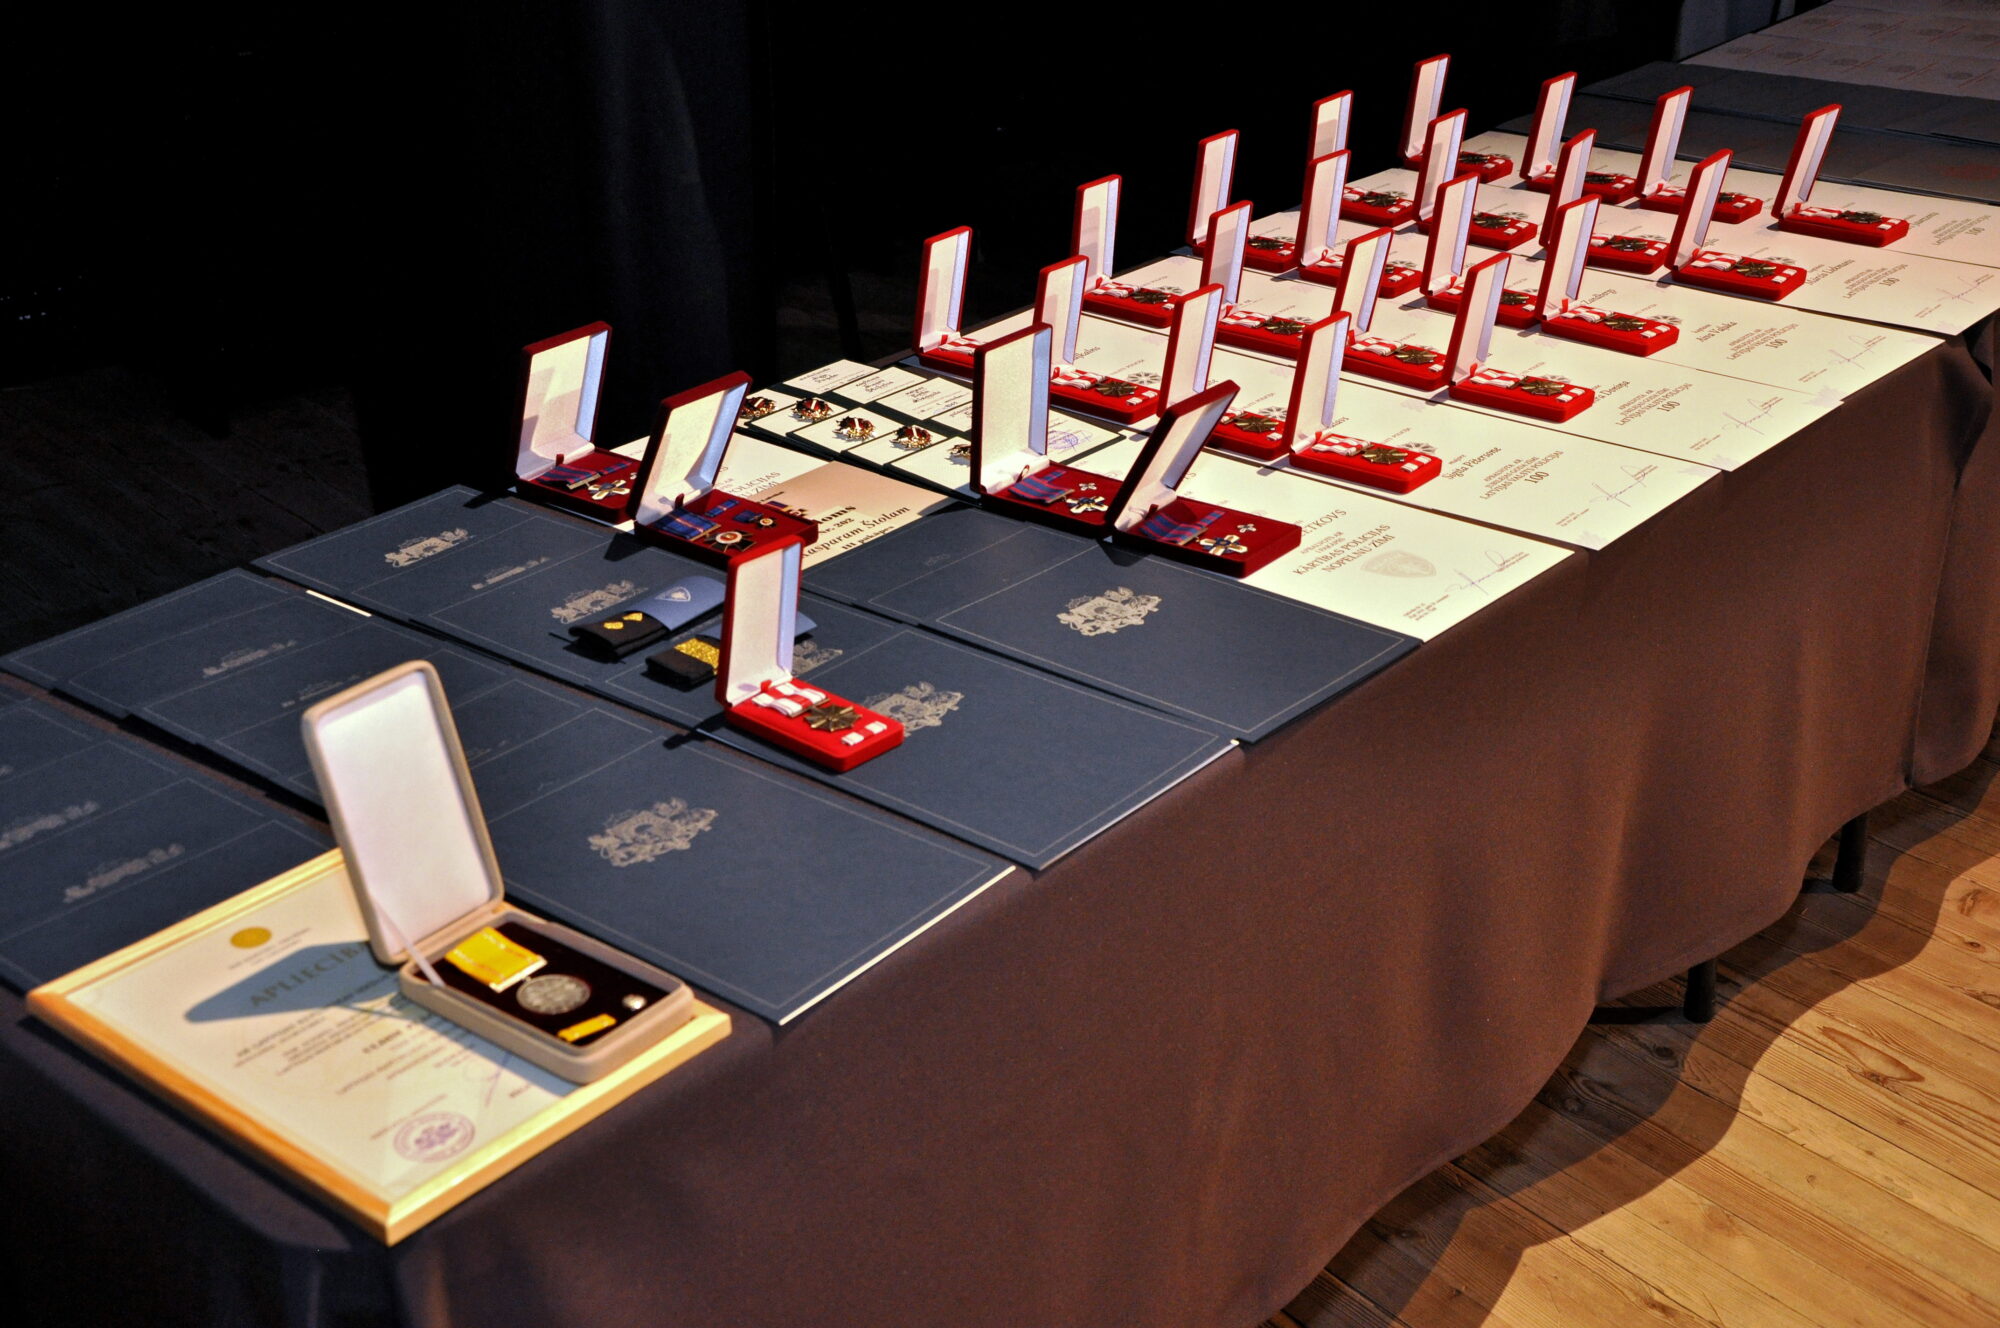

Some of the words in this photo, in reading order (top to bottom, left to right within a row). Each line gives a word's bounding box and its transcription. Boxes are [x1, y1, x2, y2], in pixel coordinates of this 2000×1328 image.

[1657, 401, 1680, 411] 100
[1524, 471, 1549, 483] 100
[1343, 524, 1391, 551] POLICIJAS
